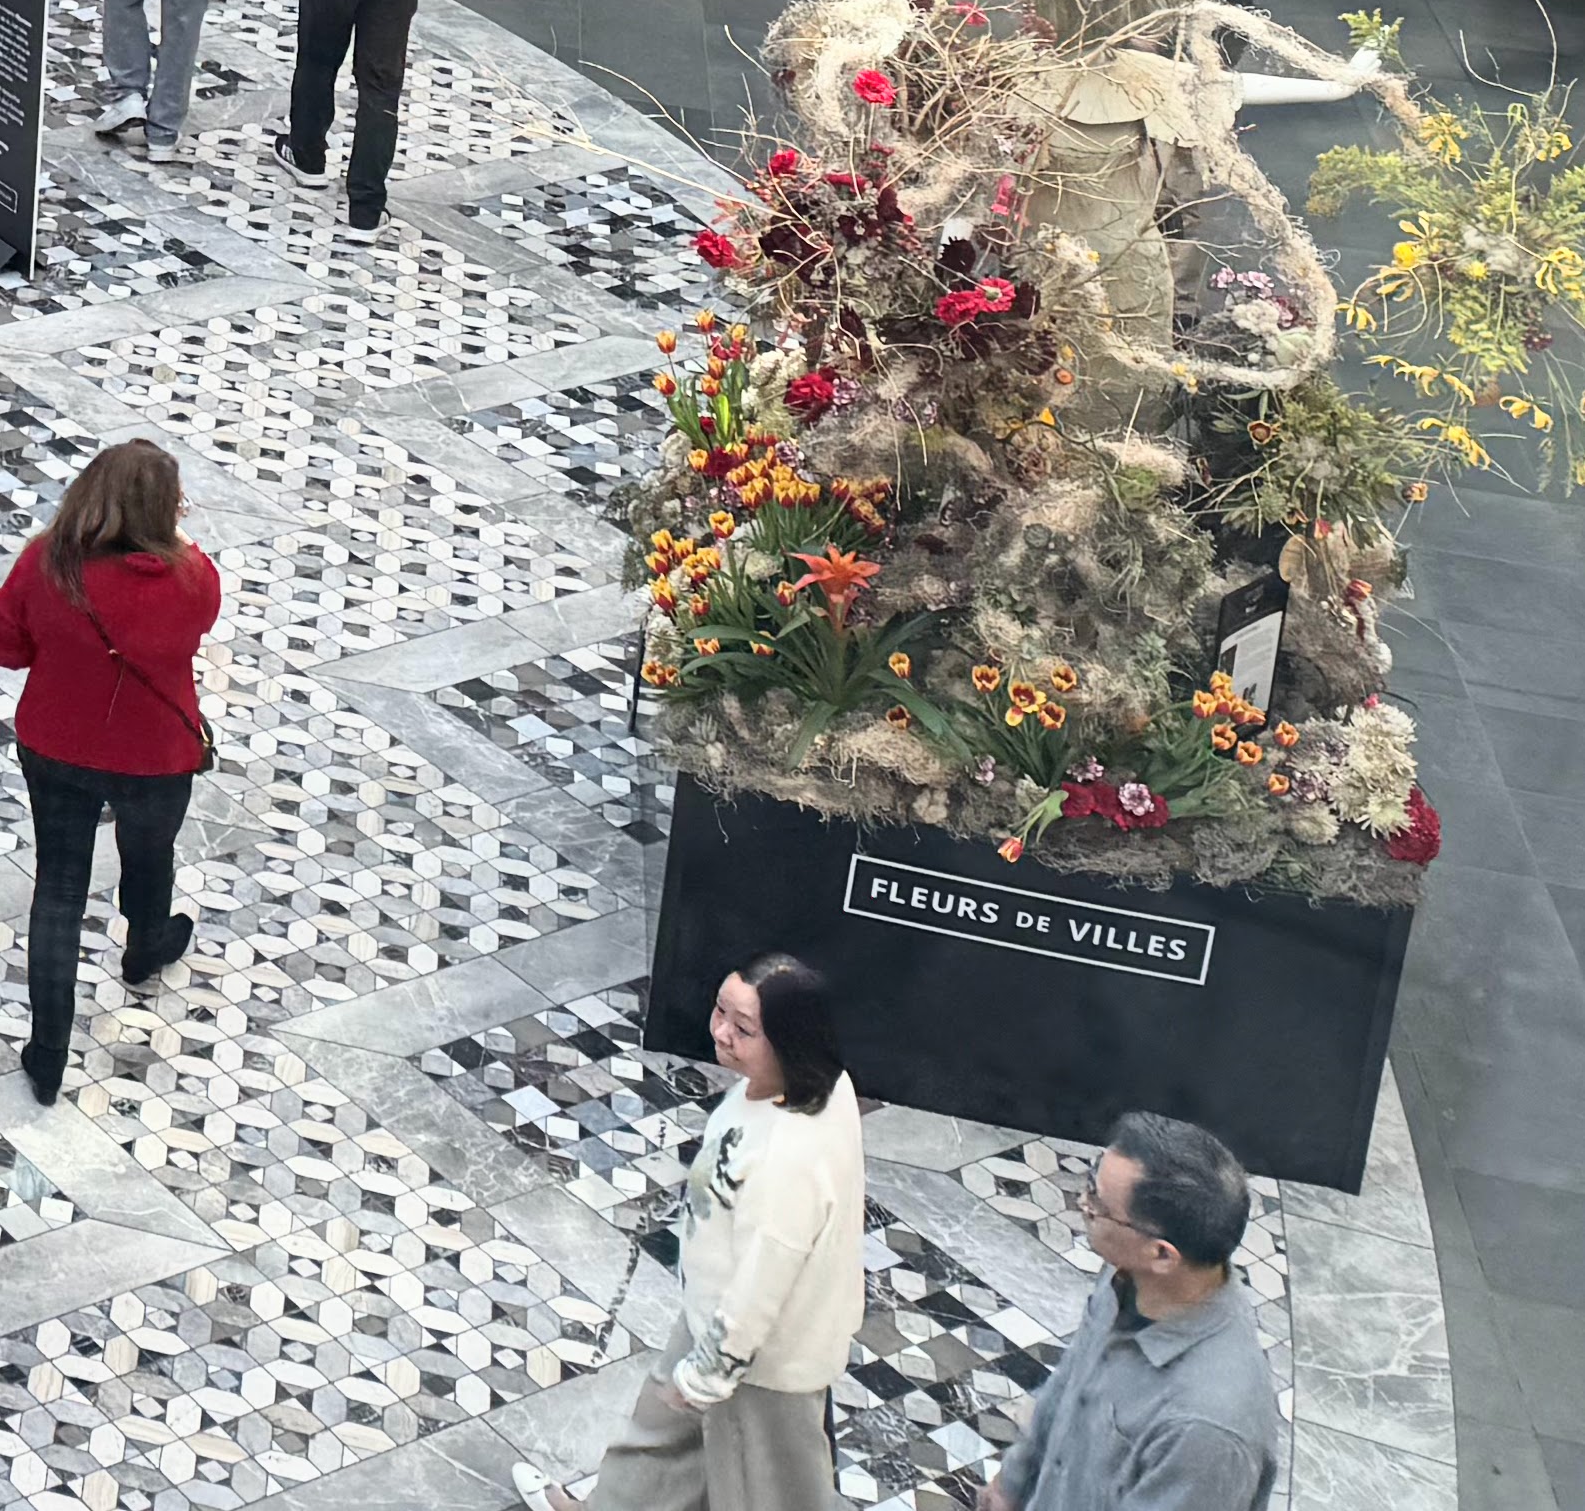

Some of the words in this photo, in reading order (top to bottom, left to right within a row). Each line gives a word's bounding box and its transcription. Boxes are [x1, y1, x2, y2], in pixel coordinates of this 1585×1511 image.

[871, 877, 1000, 924] FLEURS
[1015, 911, 1051, 933] DE
[1068, 919, 1187, 961] VILLES
